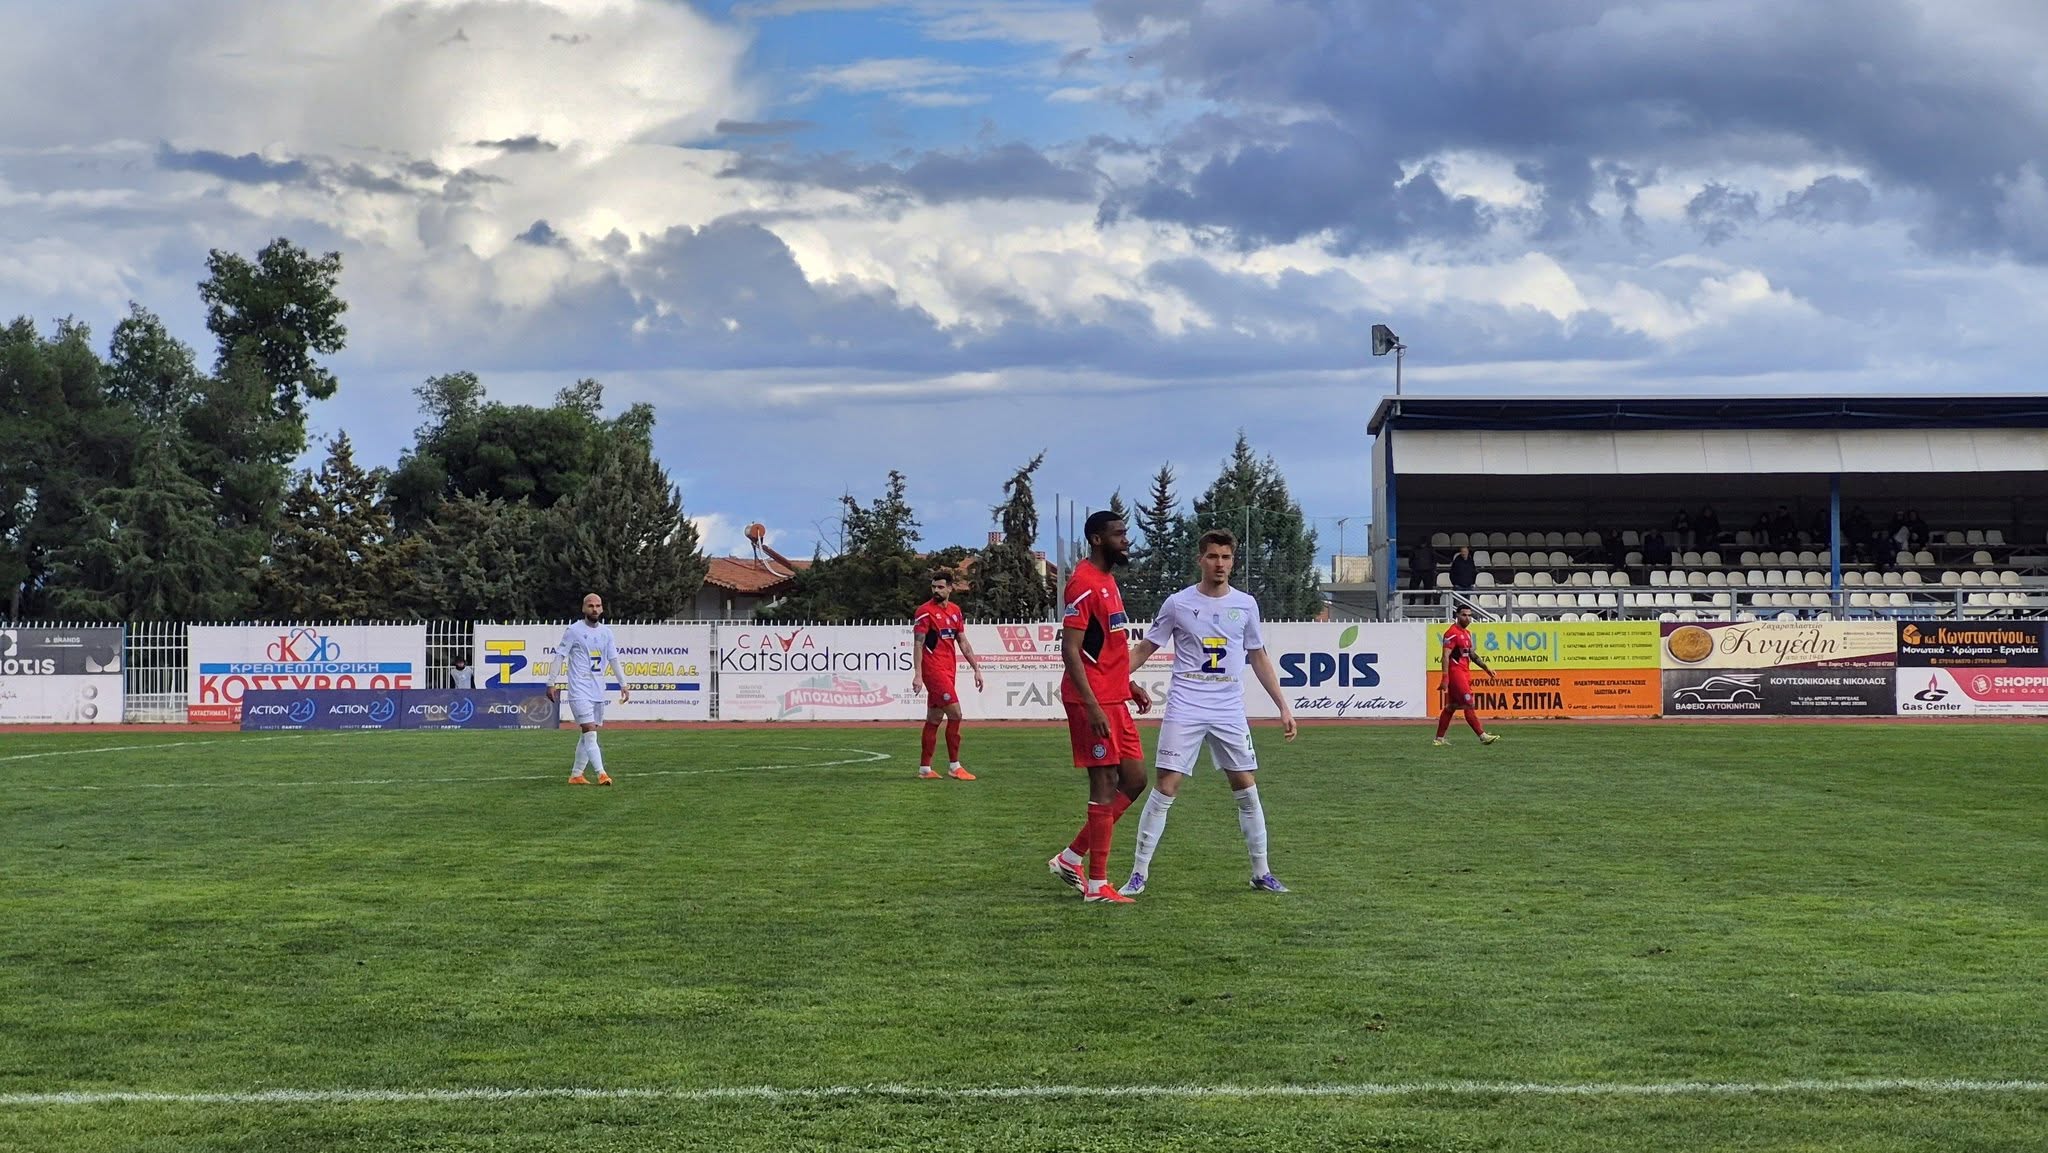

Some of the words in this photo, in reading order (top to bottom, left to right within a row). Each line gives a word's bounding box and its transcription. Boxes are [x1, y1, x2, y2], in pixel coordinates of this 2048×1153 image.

[1484, 631, 1500, 651] &
[1507, 631, 1548, 651] NOI
[1938, 628, 2023, 644] Κωνσταντίνου
[651, 647, 689, 655] ΥΛΙΚΩΝ
[1902, 646, 1945, 654] Μονωτικά
[1952, 646, 1993, 655] Χρώματα
[2000, 646, 2038, 656] Εργαλεία
[720, 646, 913, 672] Katsiadramis
[230, 663, 379, 673] ΚΡΕΑΤΕΜΠΟΡΙΚΗ
[1279, 653, 1380, 687] SPIS
[1515, 677, 1560, 686] ΕΛΕΥΘΕΡΙΟΣ
[1843, 677, 1887, 685] ΝΙΚΟΛΑΟΣ
[788, 689, 885, 707] ΜΠΟΖΙΟΝΕΛΟΣ
[1294, 696, 1335, 709] taste
[1336, 694, 1356, 716] of
[1354, 697, 1407, 709] nature
[1512, 691, 1563, 710] ΣΠΙΤΙΑ
[249, 705, 289, 714] ACTION
[291, 701, 311, 716] 24
[329, 704, 369, 714] ACTION
[371, 701, 391, 715] 24
[408, 704, 448, 714] ACTION
[450, 701, 470, 715] 24
[487, 704, 528, 714] ACTION
[529, 702, 550, 715] 24
[1902, 703, 1923, 711] Gas
[1926, 702, 1961, 711] Center
